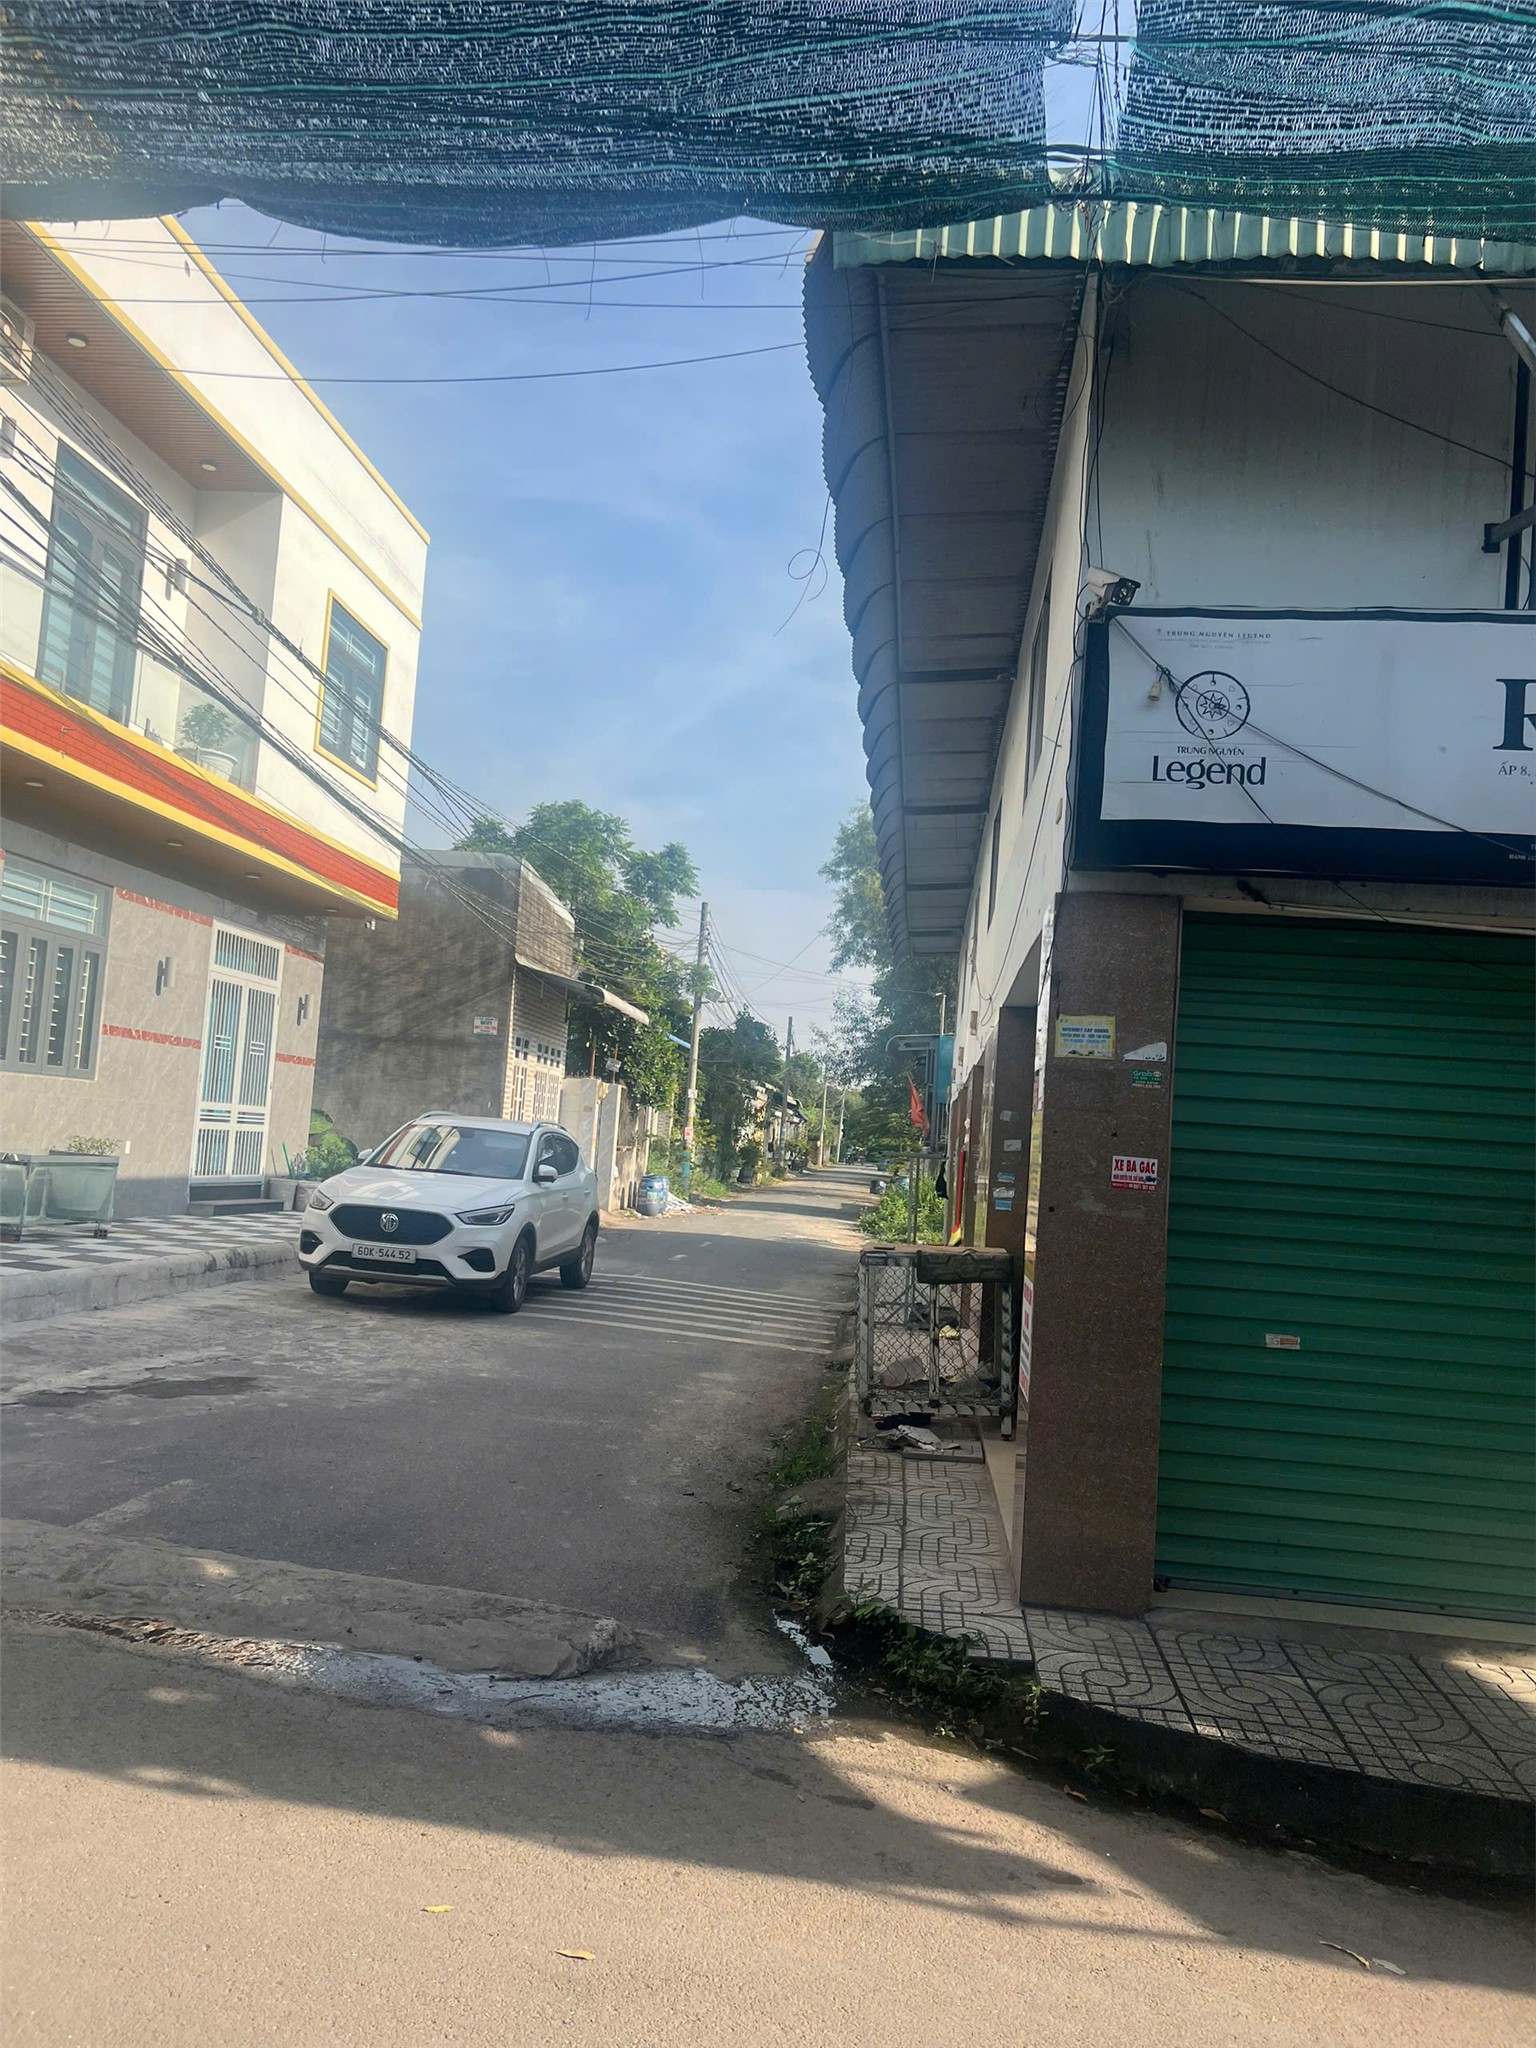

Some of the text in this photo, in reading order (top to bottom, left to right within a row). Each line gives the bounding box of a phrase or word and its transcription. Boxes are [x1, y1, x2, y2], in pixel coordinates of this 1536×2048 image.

[1177, 746, 1207, 755] TRUNG
[1152, 755, 1267, 790] Legend
[1132, 1069, 1153, 1078] Grab
[1114, 1159, 1124, 1172] XE
[1126, 1160, 1137, 1173] BA
[380, 1213, 399, 1233] MG
[357, 1246, 411, 1260] 60K-544.52
